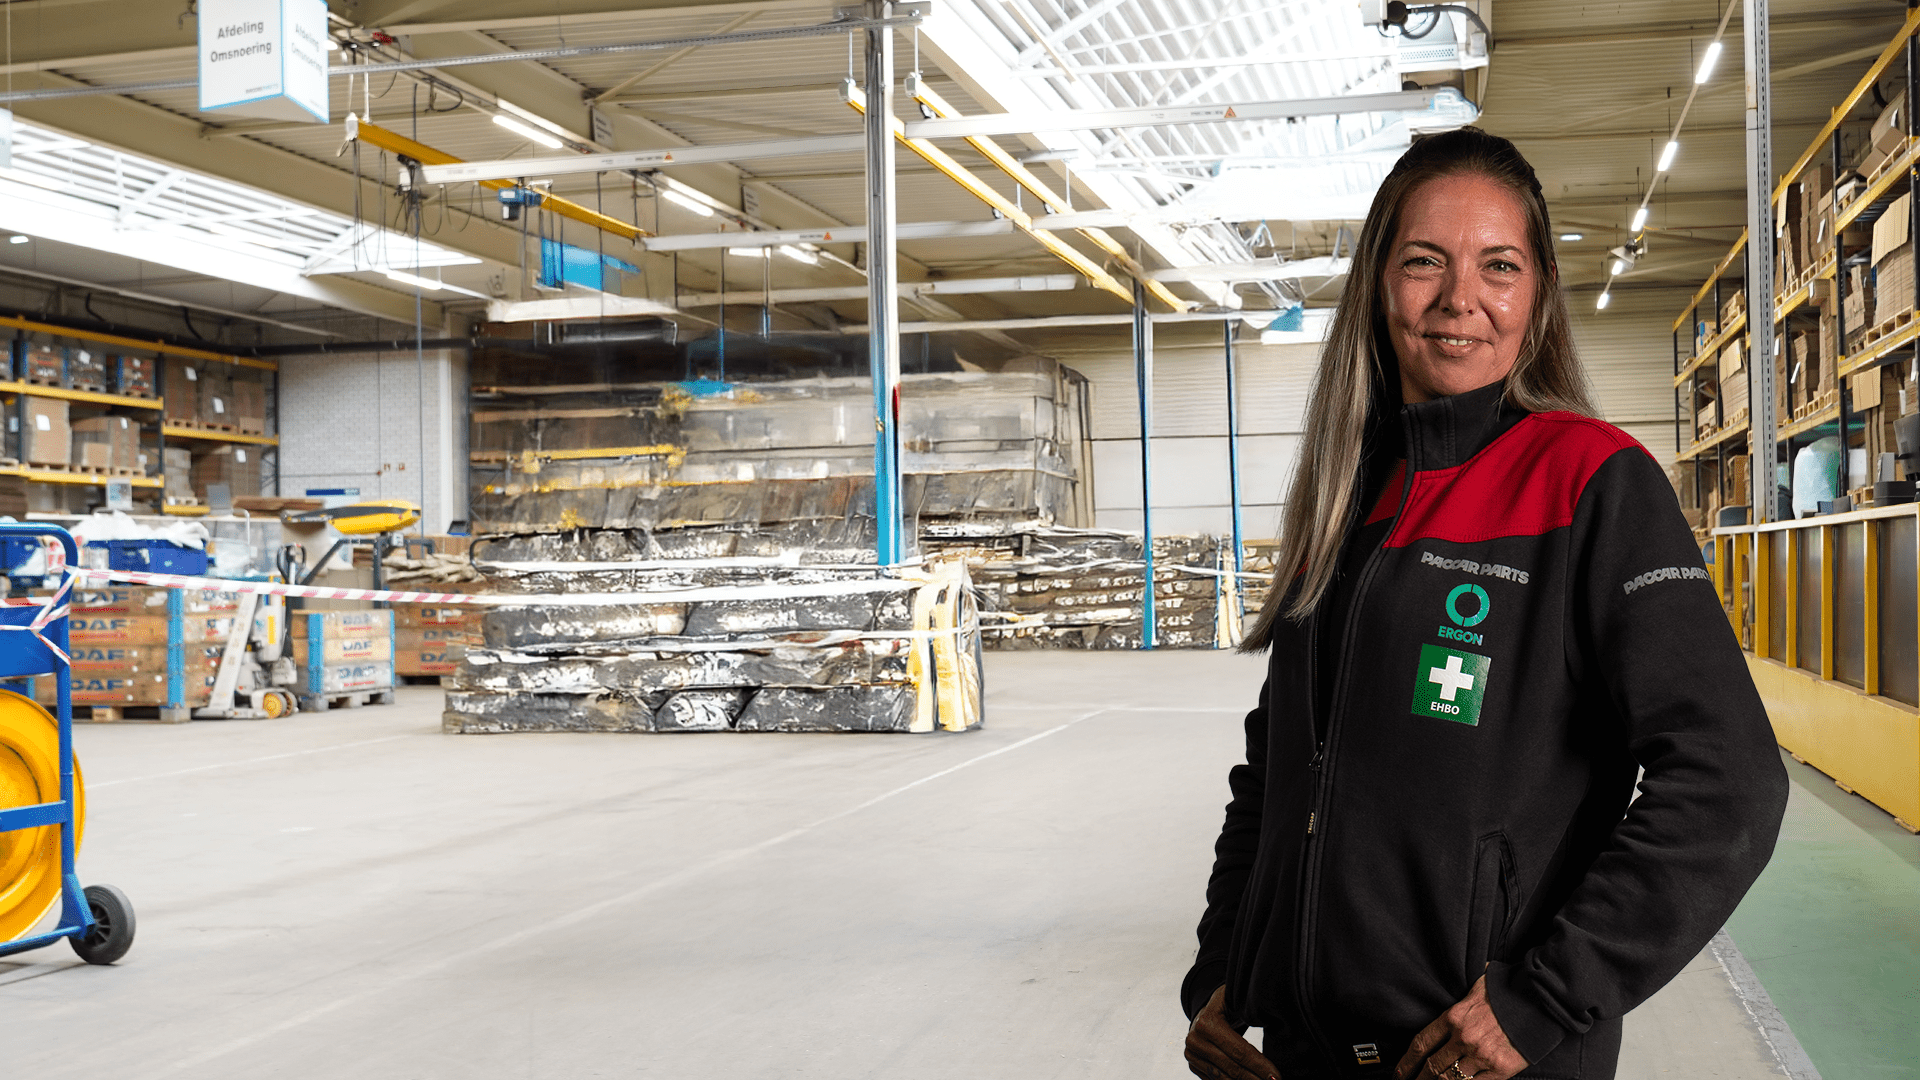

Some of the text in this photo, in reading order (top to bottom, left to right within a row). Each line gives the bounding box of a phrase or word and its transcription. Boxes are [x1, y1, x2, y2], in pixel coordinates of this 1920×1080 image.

[217, 21, 264, 39] Afdeling
[210, 42, 272, 63] Omsnoering
[1421, 551, 1530, 585] PACCAR PARTS
[1623, 566, 1711, 595] PACCAR PART
[69, 619, 127, 631] DAF
[424, 630, 461, 640] DA
[1438, 625, 1483, 646] ERGON
[70, 649, 125, 660] DAF
[421, 653, 447, 662] DA
[71, 679, 124, 691] DAF
[1430, 701, 1460, 715] EHBO
